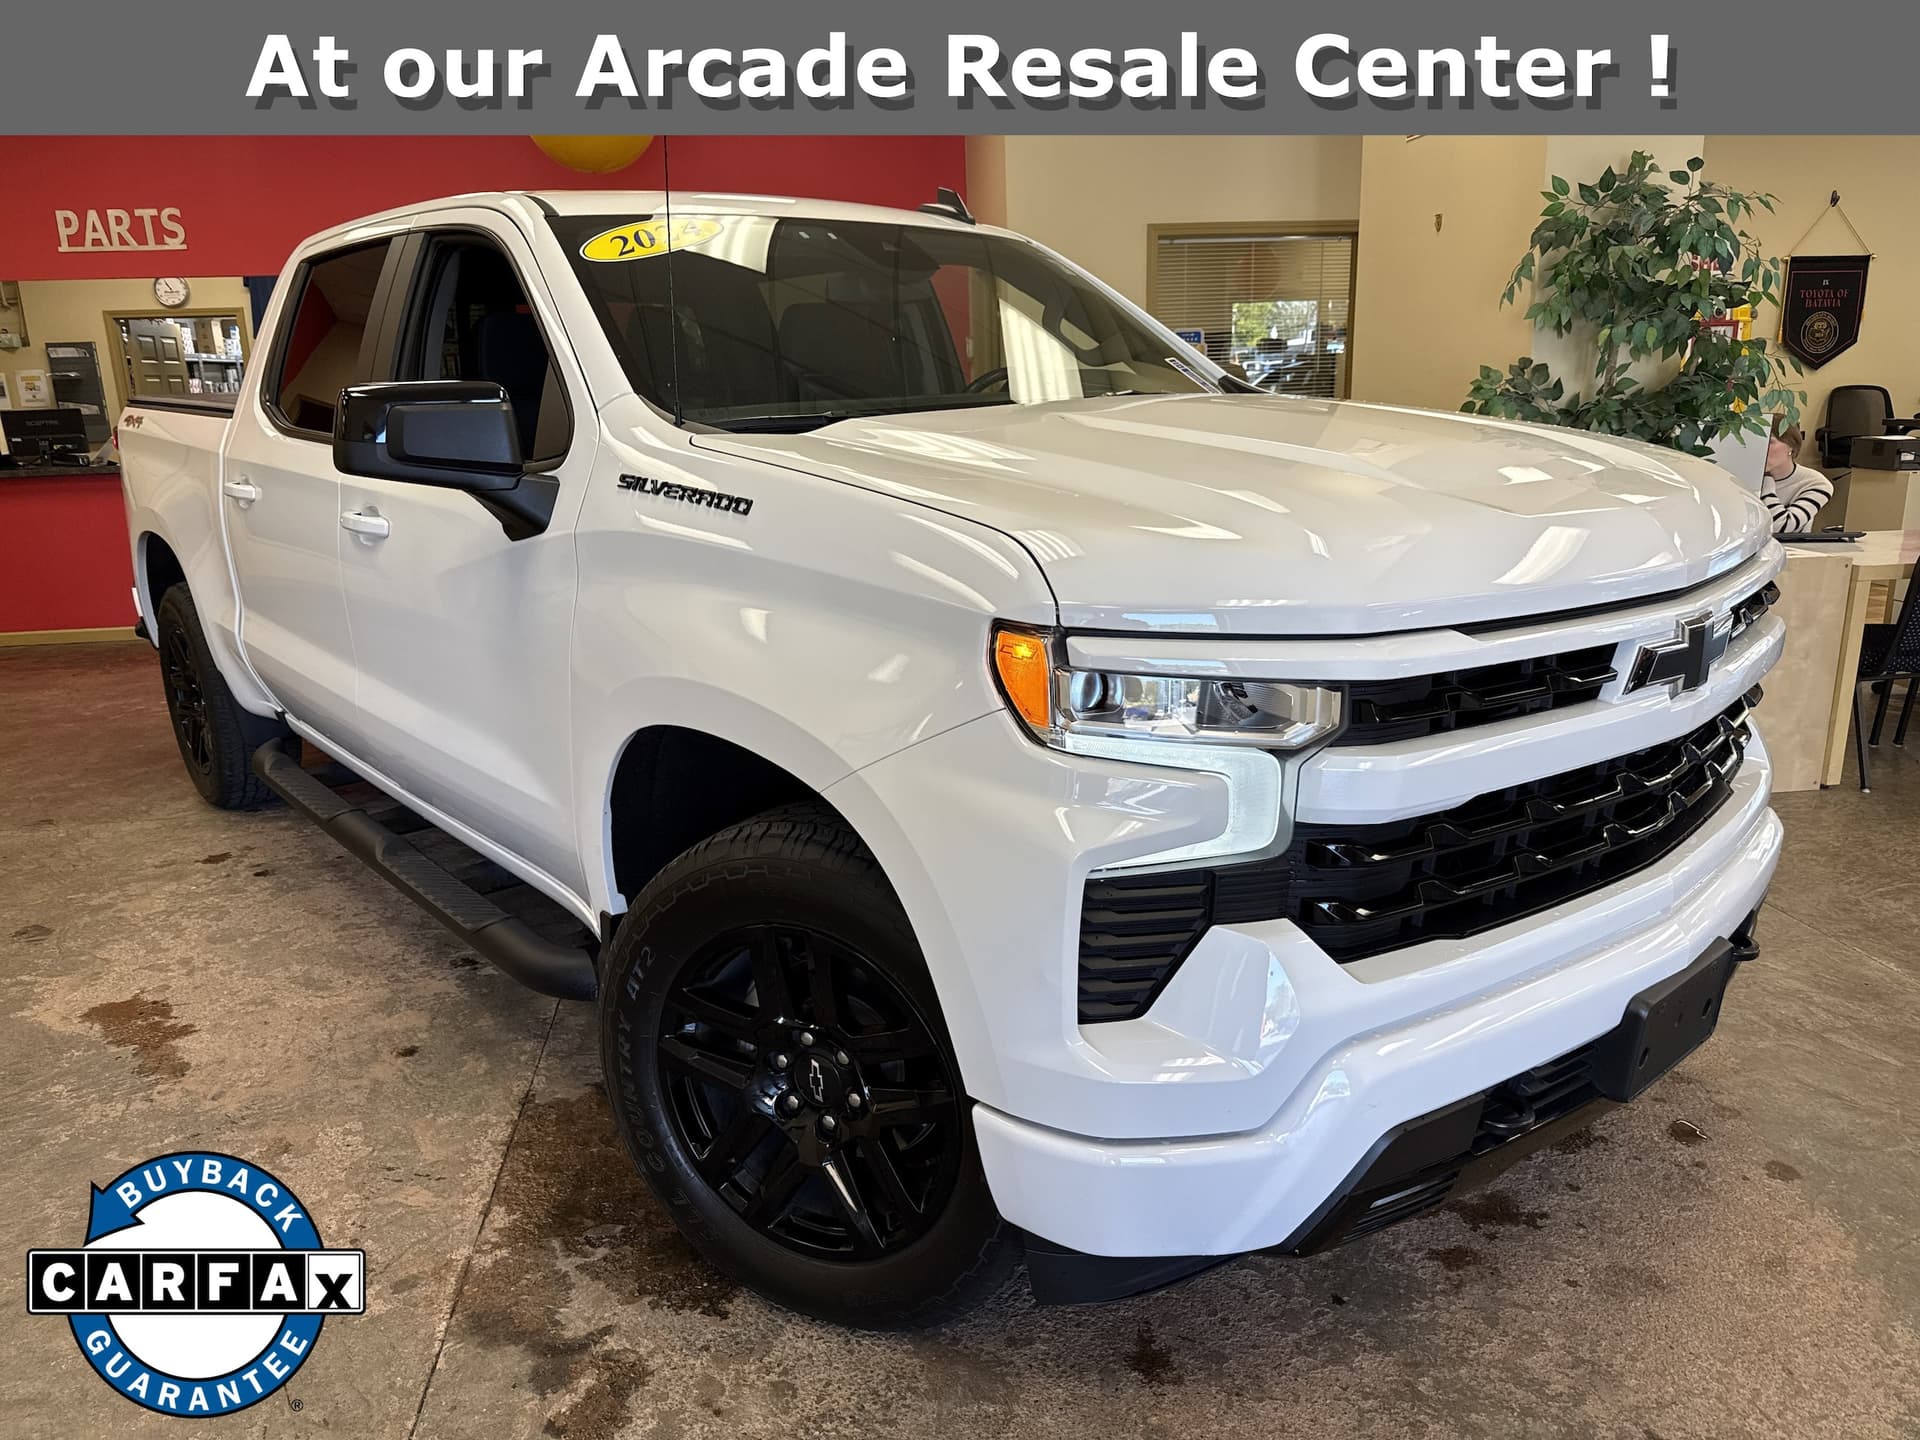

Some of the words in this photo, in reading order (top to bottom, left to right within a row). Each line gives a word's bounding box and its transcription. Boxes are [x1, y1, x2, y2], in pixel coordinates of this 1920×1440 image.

[55, 207, 188, 251] PARTS
[610, 220, 701, 257] 2024
[1800, 288, 1835, 299] TOYOTA
[1837, 289, 1849, 298] OF
[1805, 298, 1841, 308] BATAVIA
[617, 473, 754, 516] SILVERADO
[617, 1008, 667, 1174] COUNTRY
